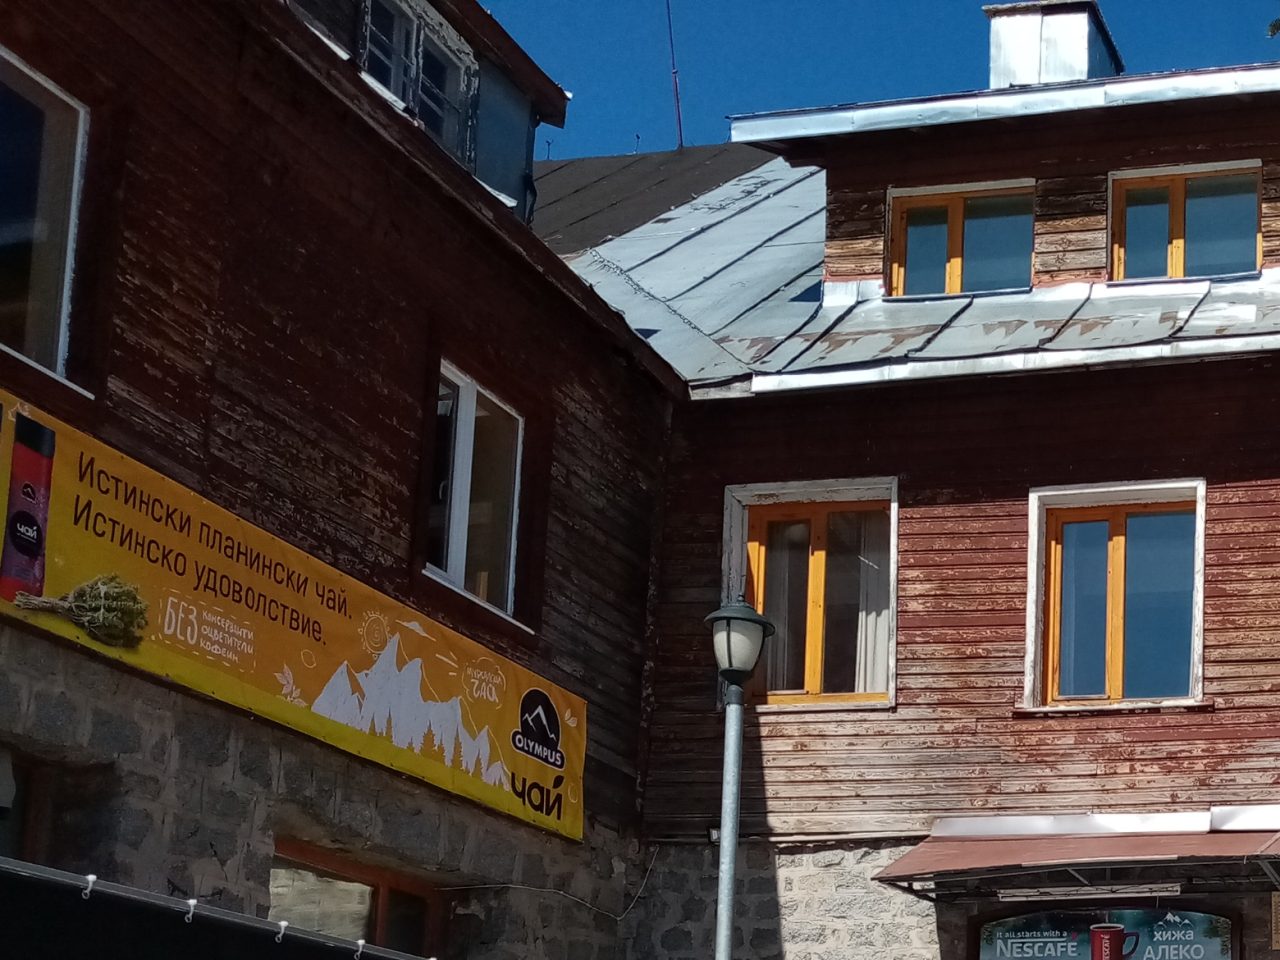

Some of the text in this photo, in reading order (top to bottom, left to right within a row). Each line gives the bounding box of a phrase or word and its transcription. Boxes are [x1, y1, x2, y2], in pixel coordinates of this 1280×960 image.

[78, 451, 352, 620] Истински планински чай.
[72, 494, 327, 647] Истинско удоволствие.
[163, 596, 198, 645] БЕЗ
[514, 734, 563, 766] OLYMPUS
[1016, 930, 1041, 938] starts
[1043, 929, 1061, 937] with
[1152, 929, 1195, 942] хижа
